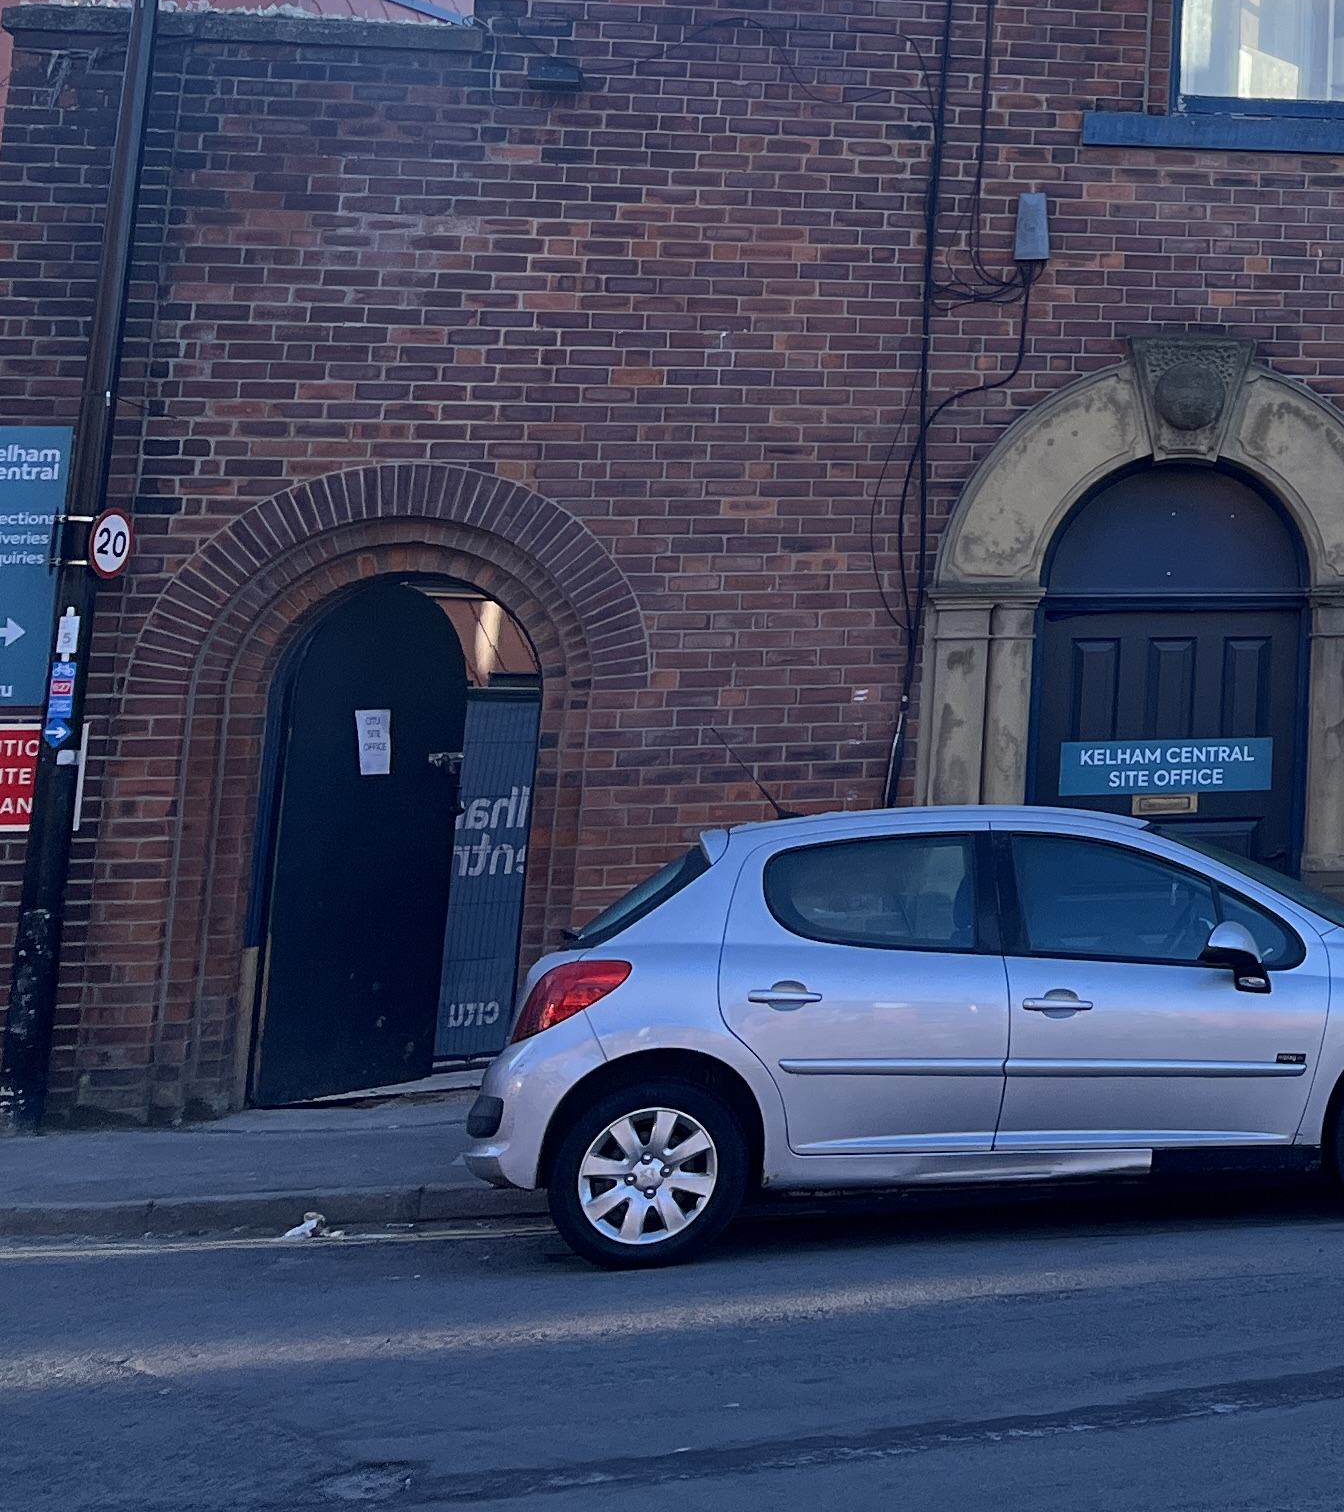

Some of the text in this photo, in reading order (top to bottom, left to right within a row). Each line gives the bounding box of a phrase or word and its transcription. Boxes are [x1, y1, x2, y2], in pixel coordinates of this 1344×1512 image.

[97, 527, 127, 558] 20
[1080, 745, 1255, 766] KELHAM CENTRAL
[1108, 768, 1224, 787] SITE OFFICE
